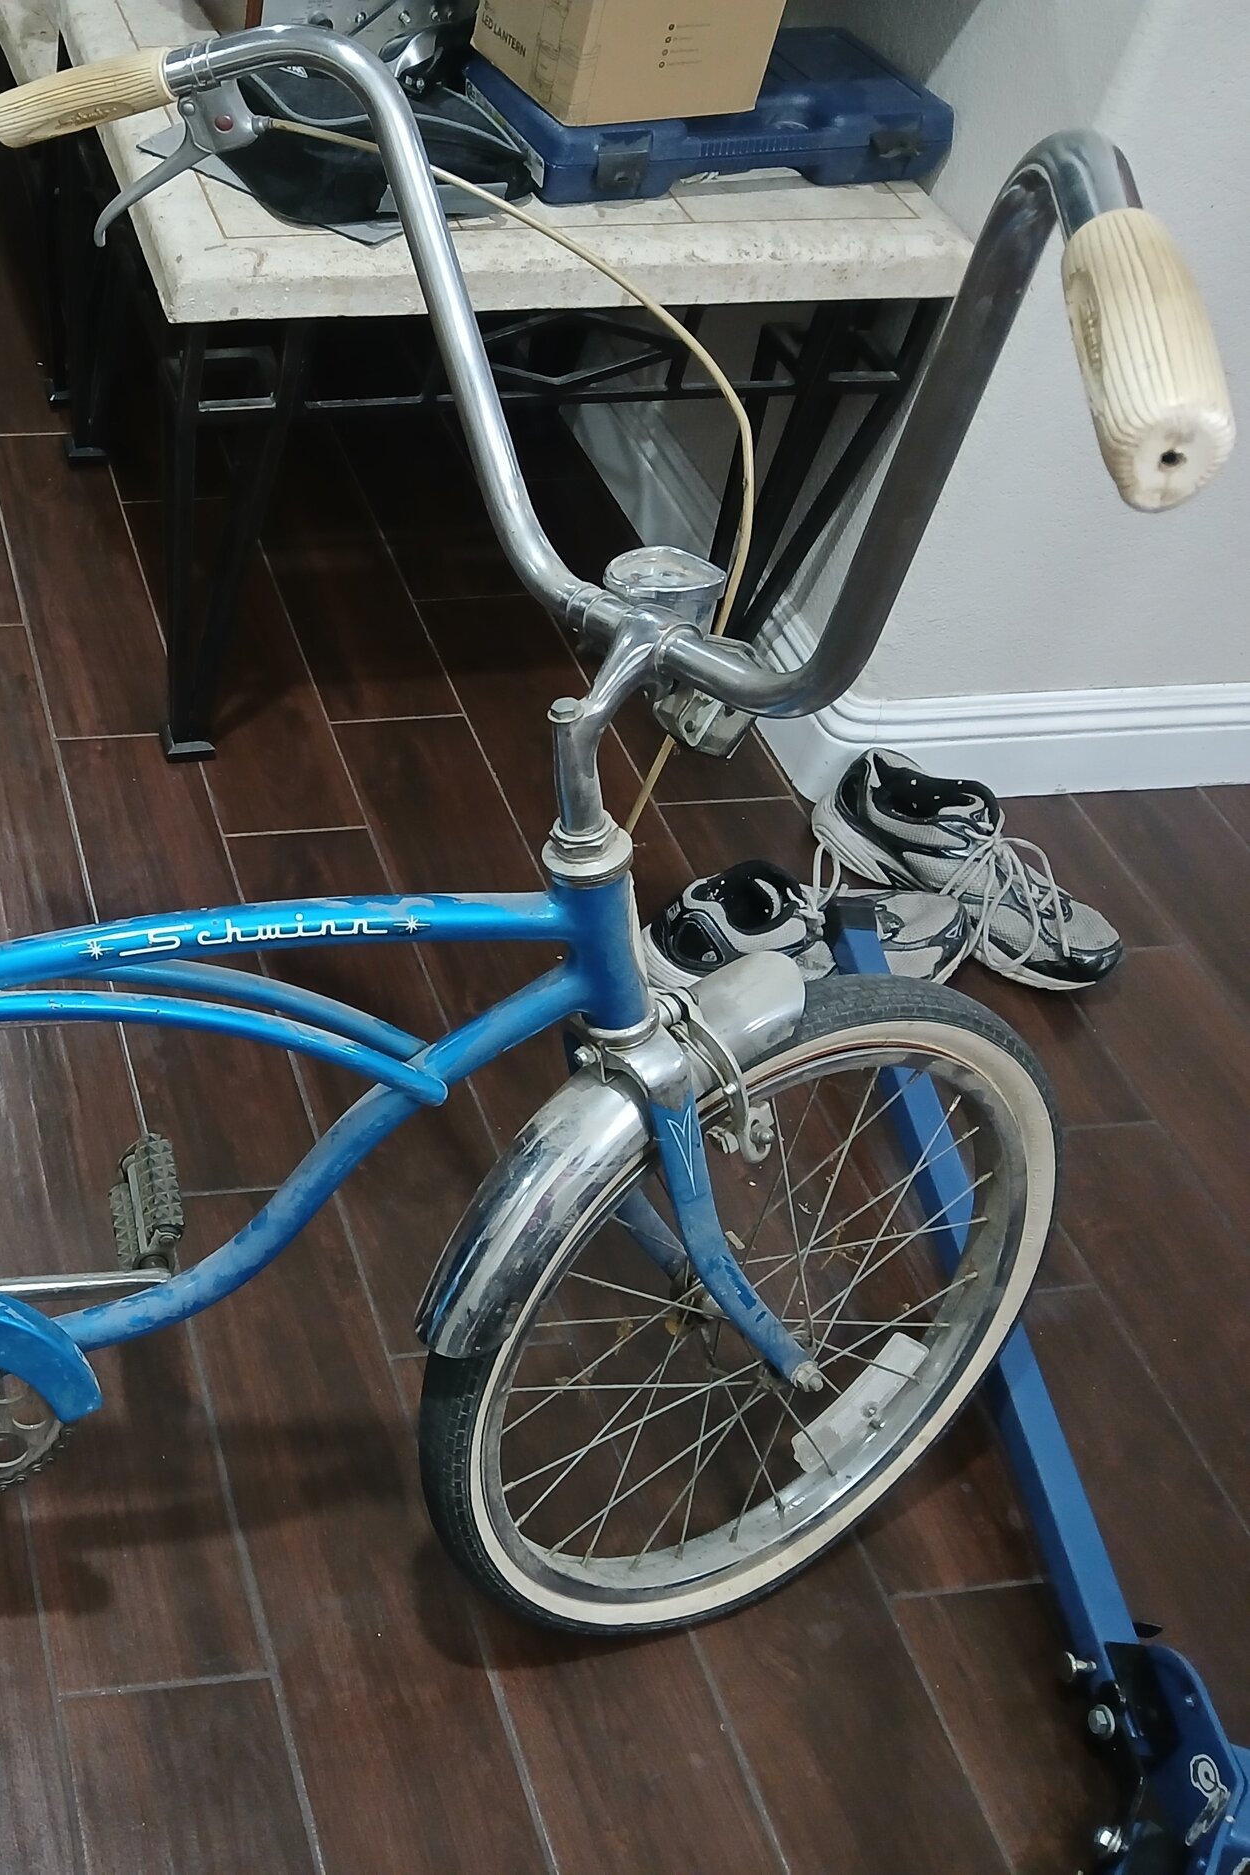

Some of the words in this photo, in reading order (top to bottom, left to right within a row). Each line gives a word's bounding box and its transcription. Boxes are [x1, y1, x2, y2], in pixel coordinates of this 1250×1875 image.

[481, 12, 494, 30] LED
[493, 24, 527, 58] LANTERN
[118, 912, 389, 958] Schwinn
